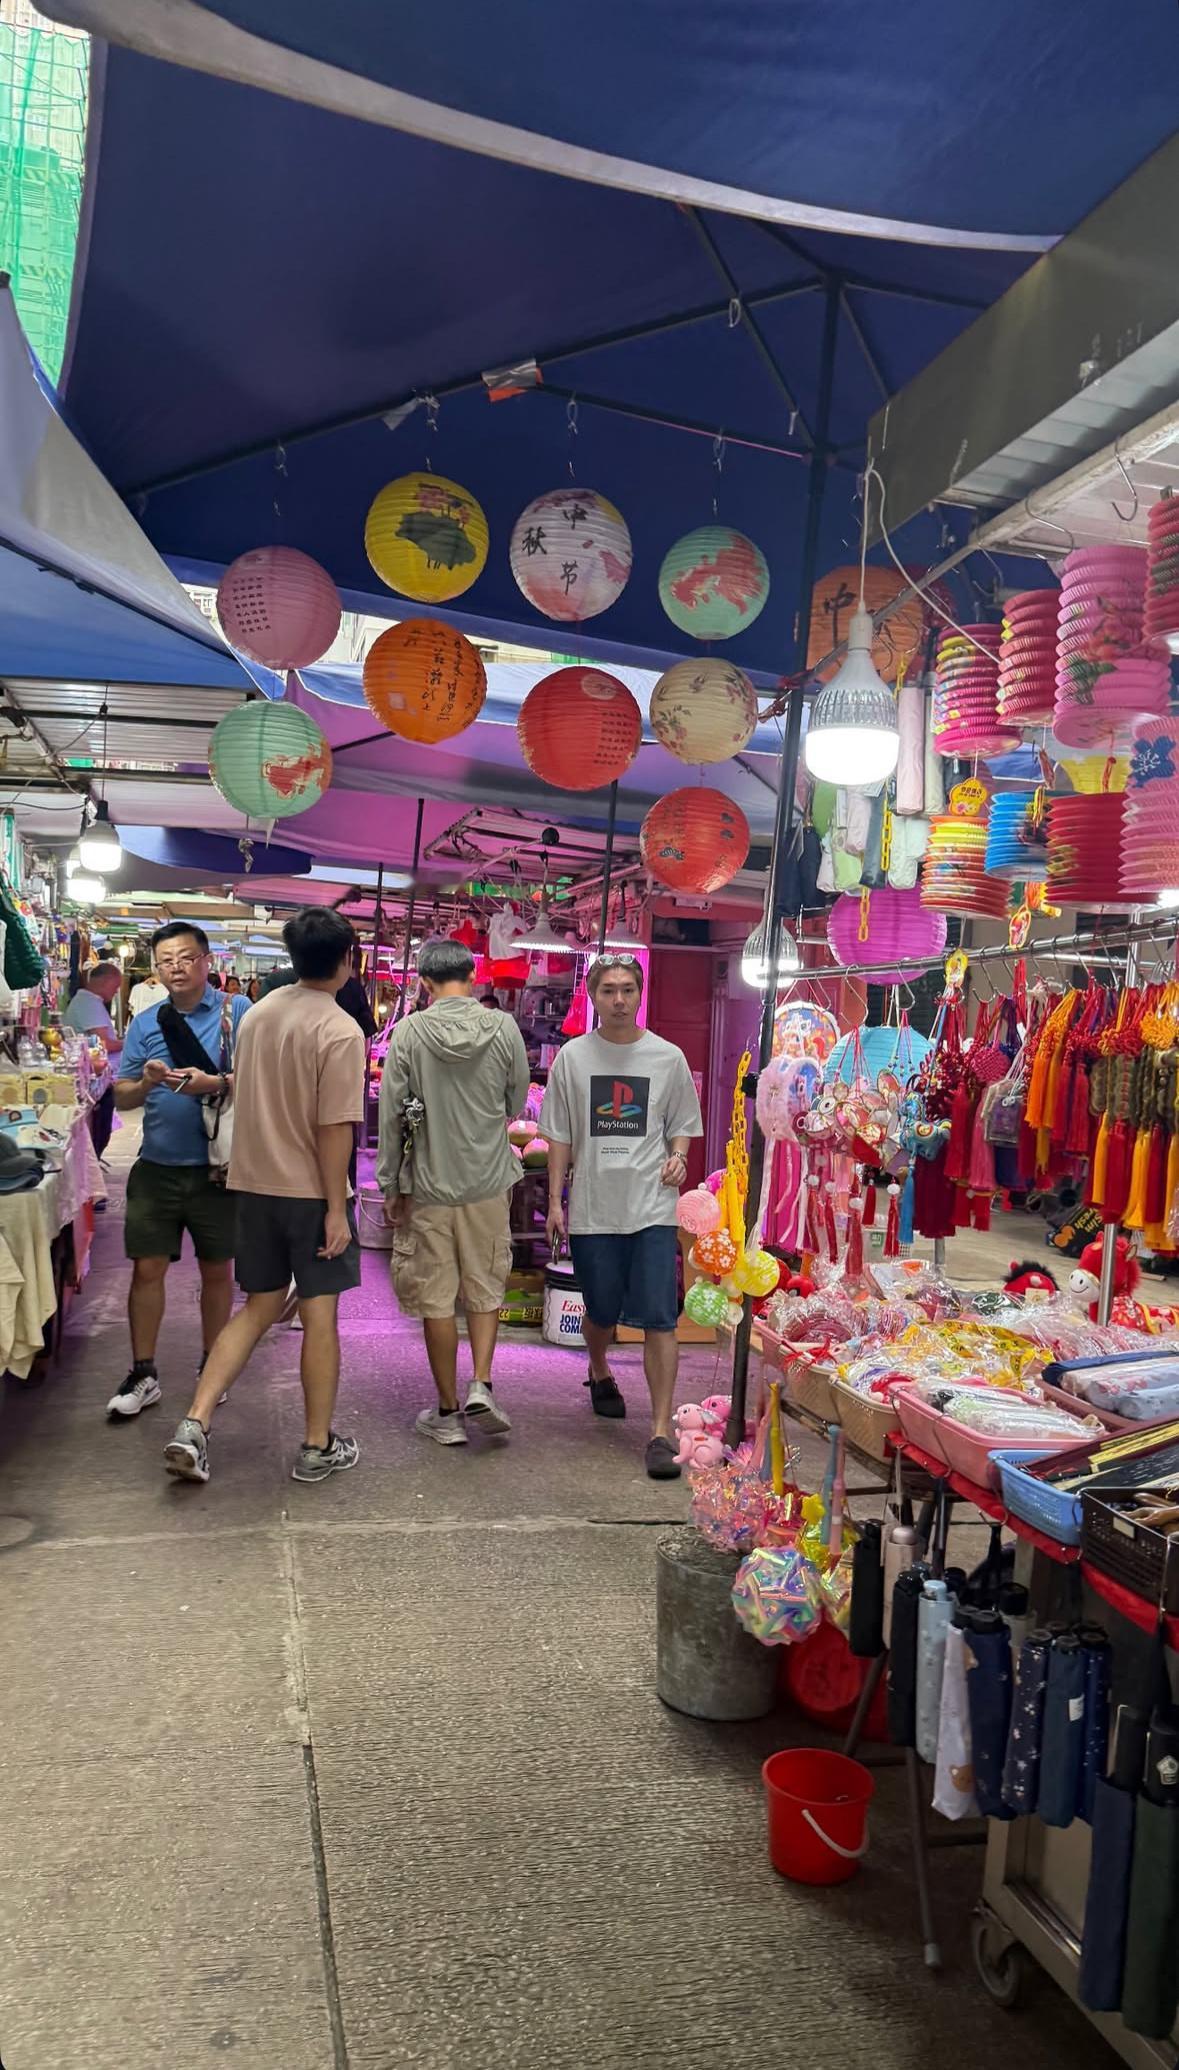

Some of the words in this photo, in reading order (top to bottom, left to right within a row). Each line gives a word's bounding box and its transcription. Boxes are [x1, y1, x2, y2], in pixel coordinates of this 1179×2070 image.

[597, 1120, 639, 1130] PlayStation
[560, 1314, 581, 1325] JOIN
[560, 1324, 583, 1334] COM
